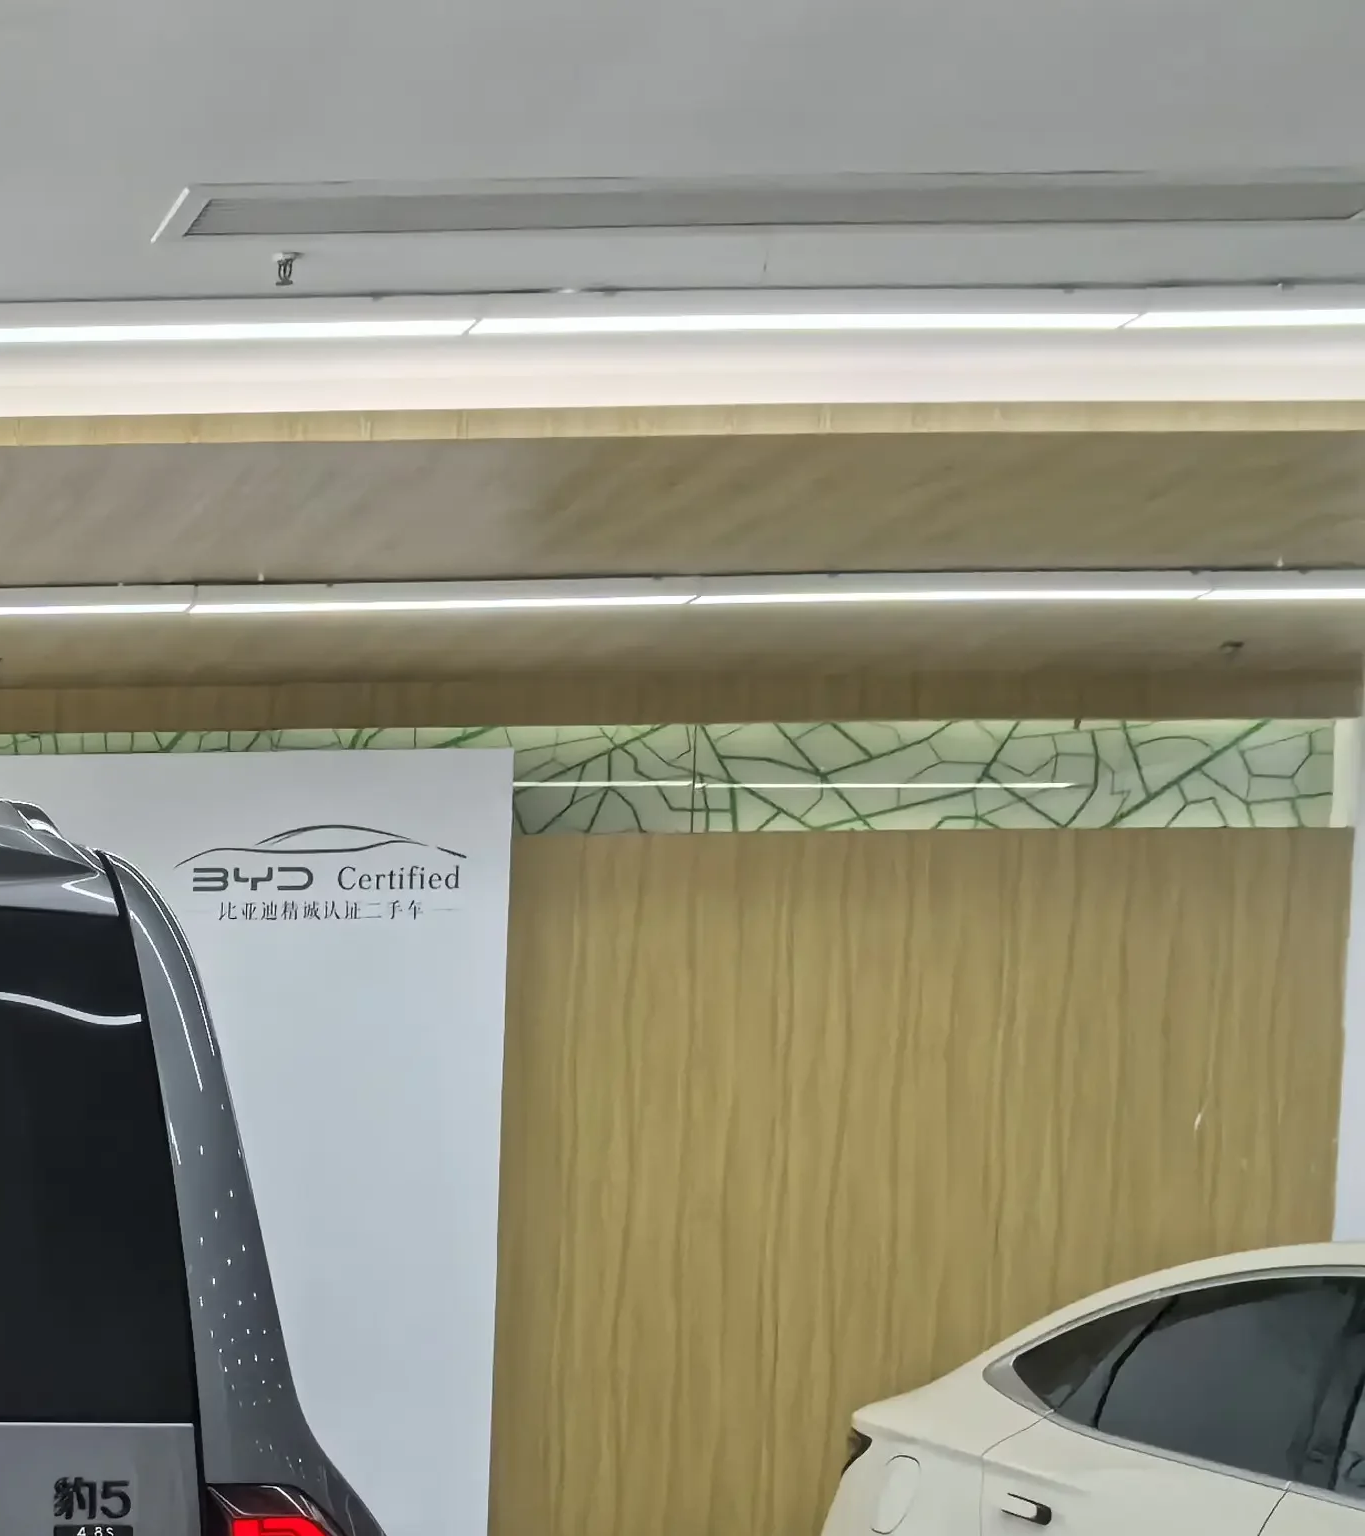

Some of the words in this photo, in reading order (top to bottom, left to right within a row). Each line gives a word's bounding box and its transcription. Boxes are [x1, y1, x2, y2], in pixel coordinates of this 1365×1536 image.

[193, 867, 314, 892] BYD
[337, 865, 460, 890] Certified
[218, 899, 424, 921] 比亚迪精诚认证二手车
[53, 1476, 132, 1520] 豹5
